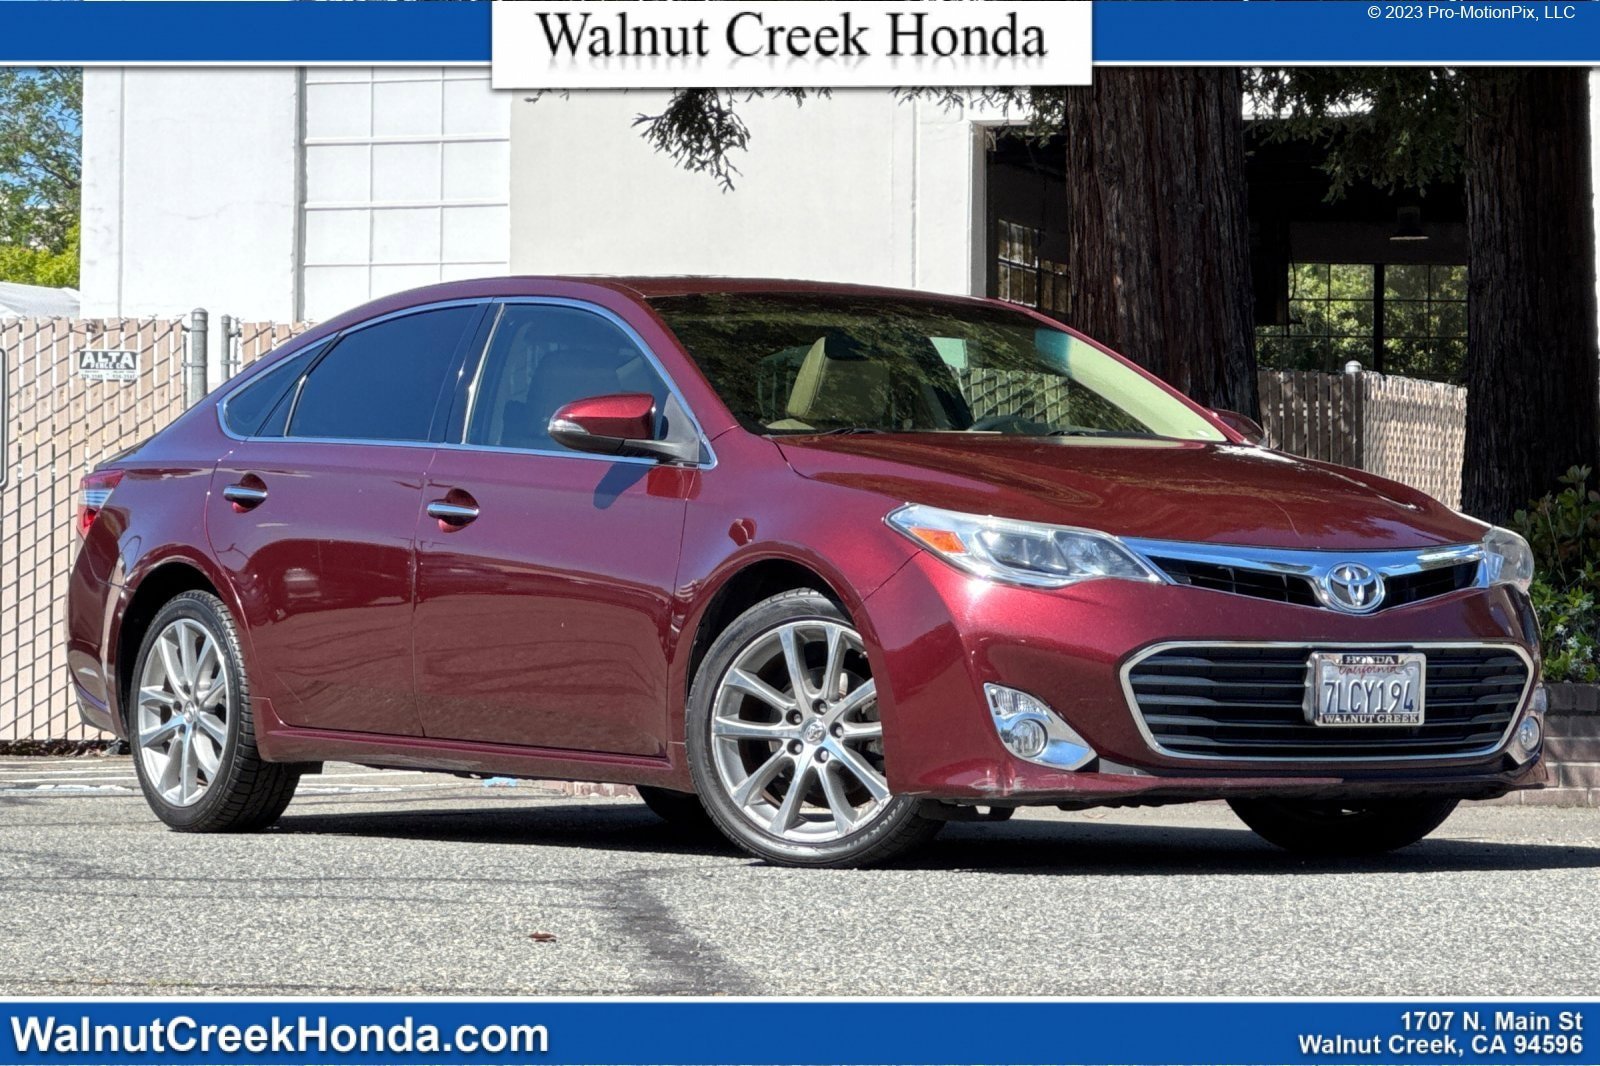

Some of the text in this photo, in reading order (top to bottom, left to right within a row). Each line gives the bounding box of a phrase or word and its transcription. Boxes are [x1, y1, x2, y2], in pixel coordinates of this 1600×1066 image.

[81, 352, 135, 368] ALTA
[1345, 655, 1395, 664] HONDA
[1339, 665, 1403, 680] California
[1324, 680, 1414, 713] 7LCY194
[1325, 714, 1418, 723] WALNUT CREEK
